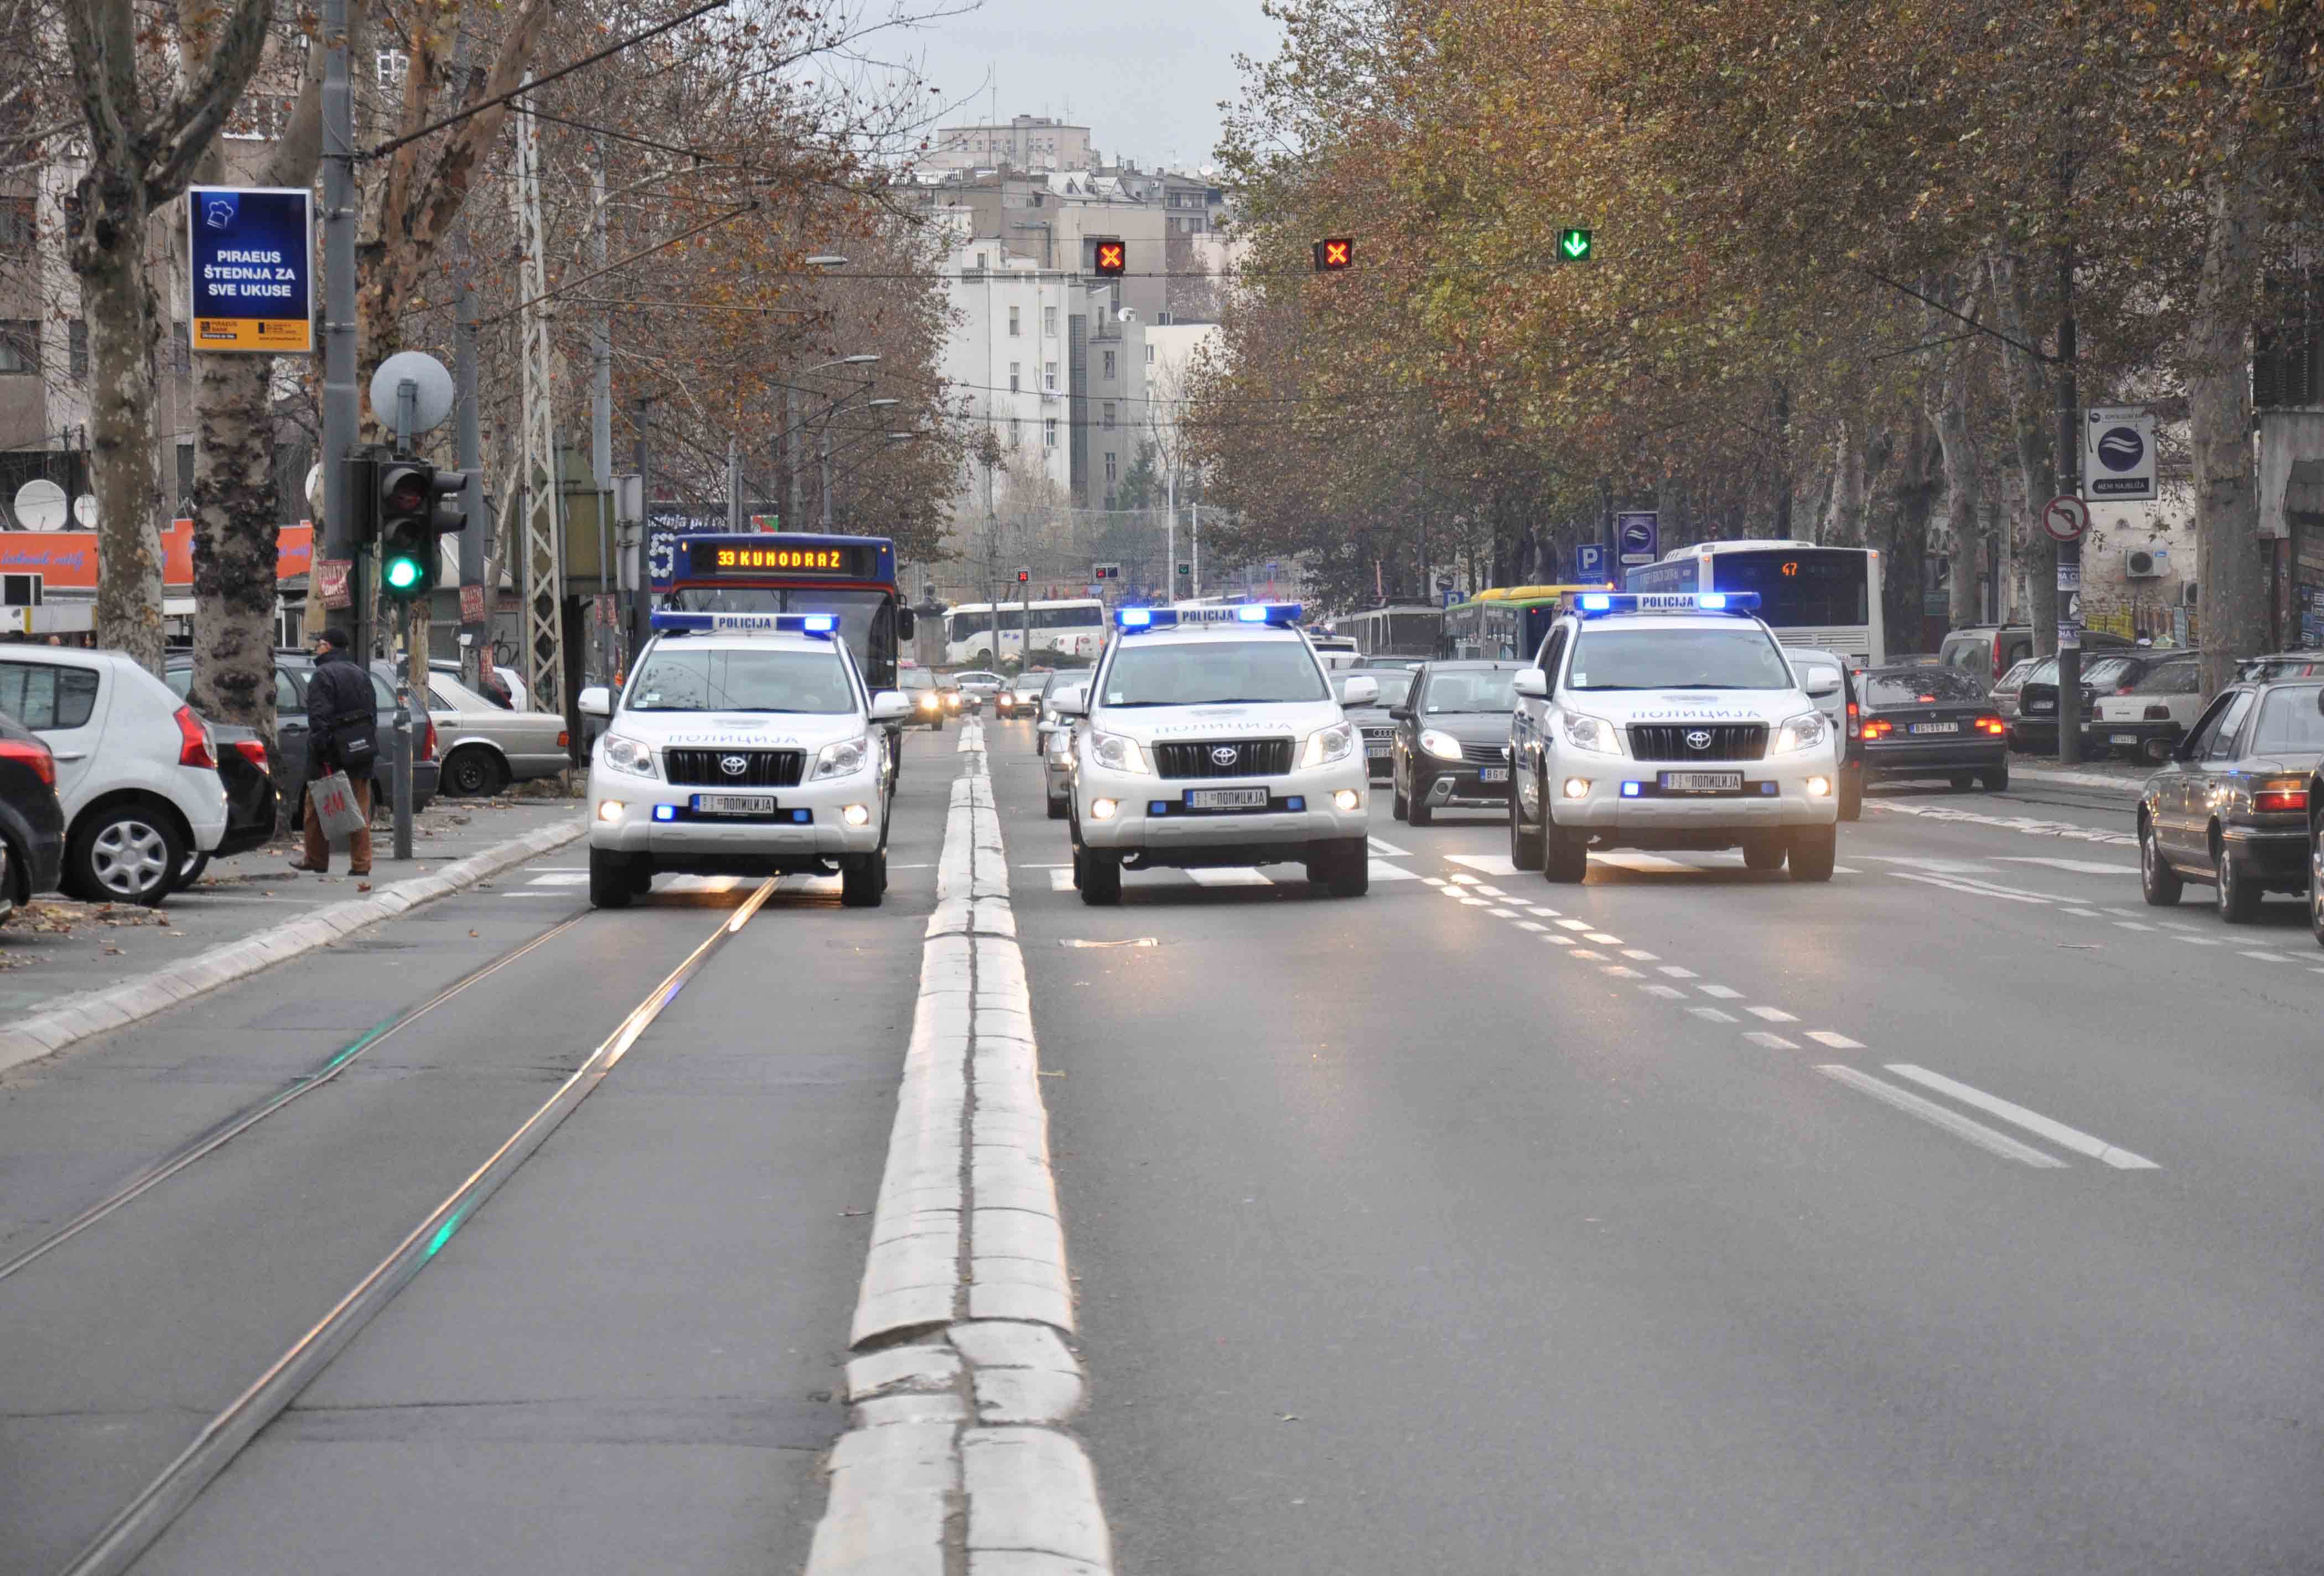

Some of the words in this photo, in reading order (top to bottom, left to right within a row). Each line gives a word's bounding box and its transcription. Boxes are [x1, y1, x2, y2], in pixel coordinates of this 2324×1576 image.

[217, 250, 281, 263] PIRAEUS
[204, 264, 271, 280] ŠTEDNJA
[275, 268, 296, 281] ZA
[208, 284, 237, 296] SVE
[241, 284, 292, 297] UKUSE
[718, 551, 735, 566] 33
[1782, 562, 1798, 576] 47
[1643, 597, 1693, 608] POLICIJA
[1182, 609, 1234, 621] POLICIJA
[719, 617, 771, 629] POLICIJA
[1486, 770, 1498, 779] BG
